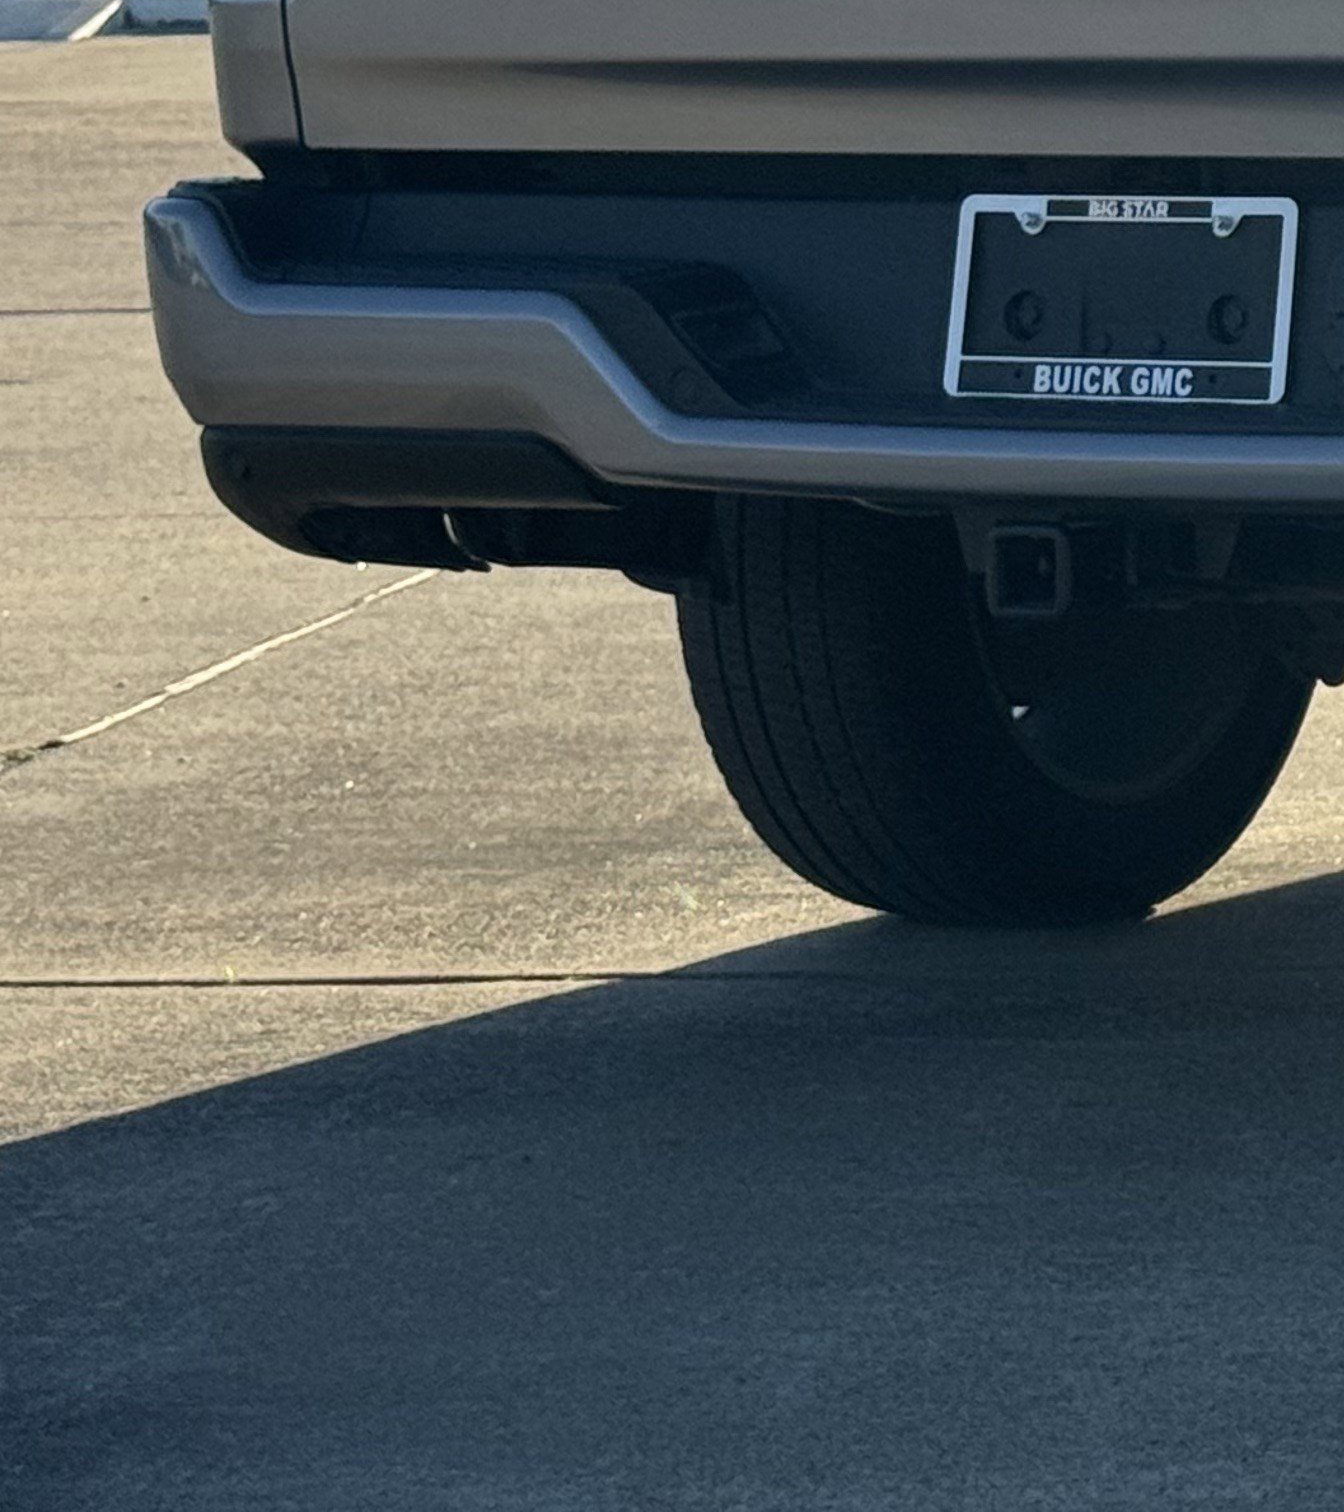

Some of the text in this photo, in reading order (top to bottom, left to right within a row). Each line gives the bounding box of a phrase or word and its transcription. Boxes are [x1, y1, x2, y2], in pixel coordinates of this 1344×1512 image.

[1088, 199, 1169, 218] BIG STAR
[1033, 364, 1194, 396] BUICK GMC
